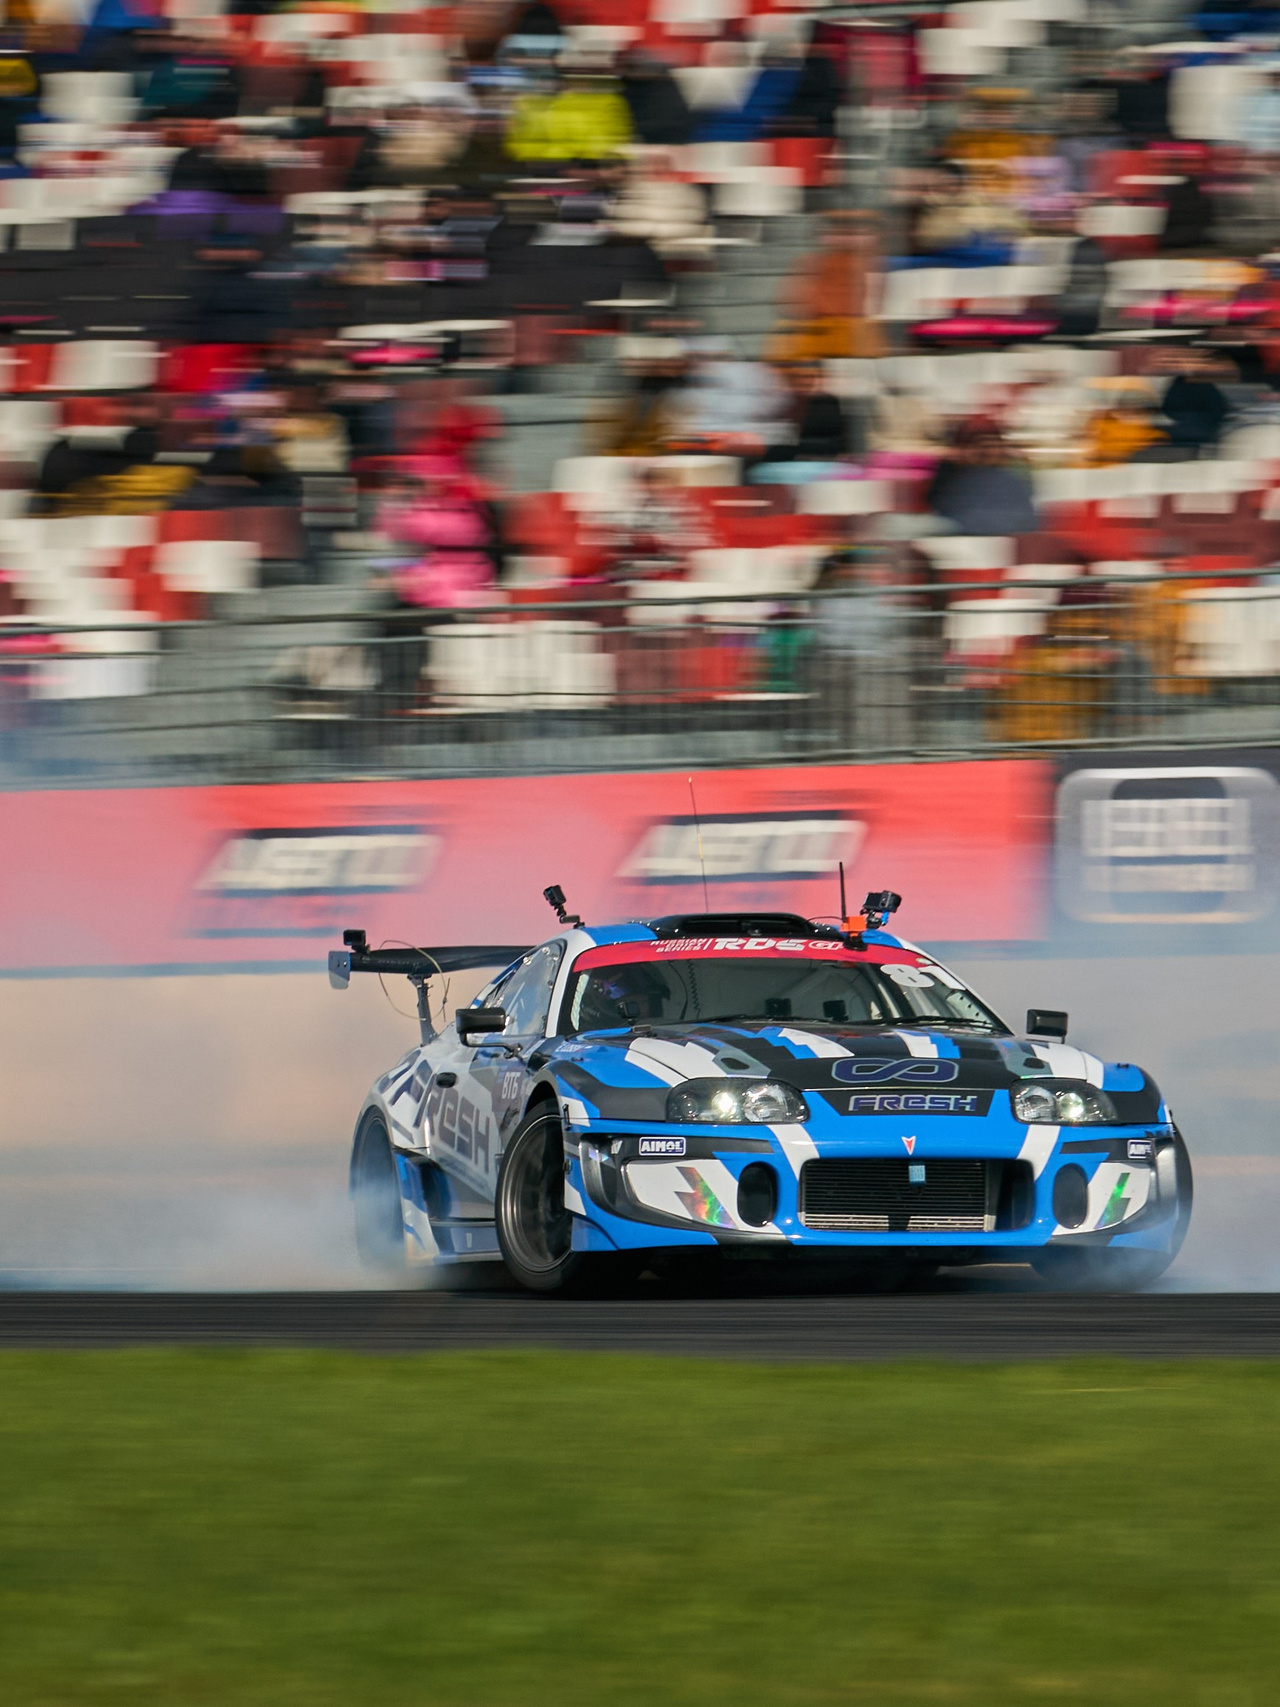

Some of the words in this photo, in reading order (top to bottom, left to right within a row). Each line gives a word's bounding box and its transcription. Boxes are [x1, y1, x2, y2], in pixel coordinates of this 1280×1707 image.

[712, 938, 808, 951] RDS
[880, 963, 967, 992] 81
[849, 1095, 977, 1111] FRESH
[641, 1141, 683, 1152] AIMOL
